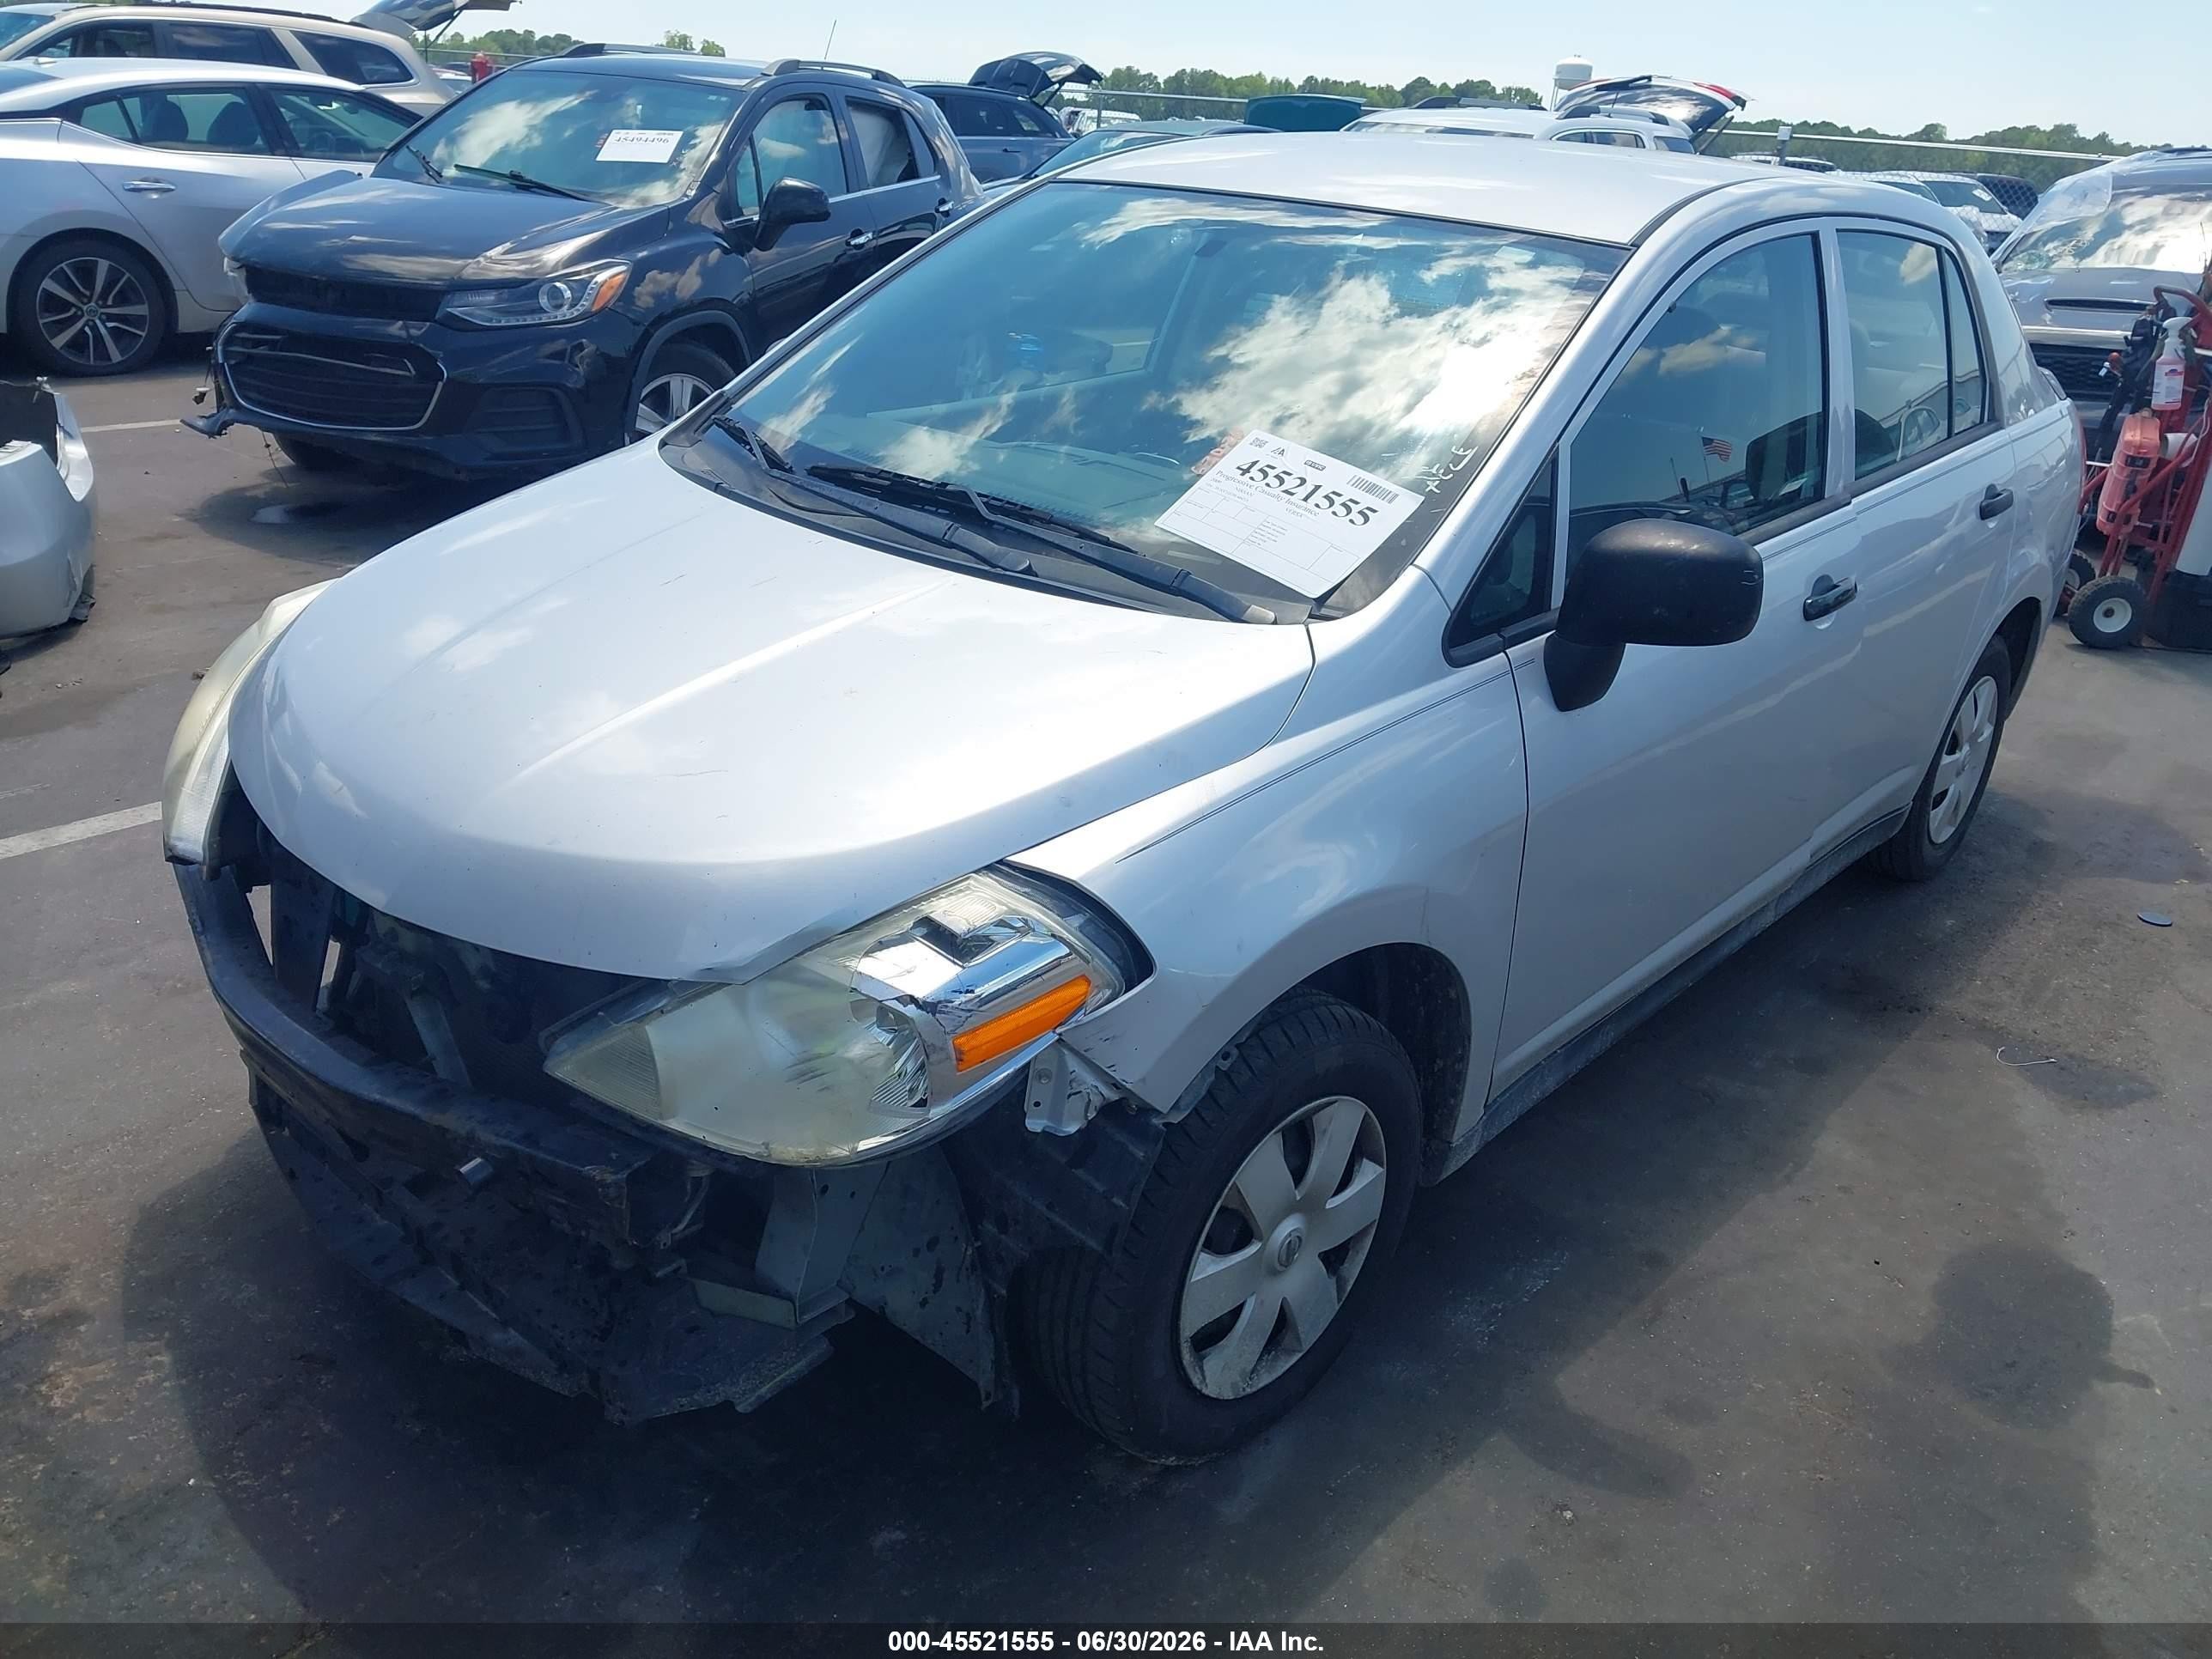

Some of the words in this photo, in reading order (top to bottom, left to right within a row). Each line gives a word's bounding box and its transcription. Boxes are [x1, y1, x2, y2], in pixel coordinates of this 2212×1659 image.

[1215, 470, 1255, 489] Progressive
[1255, 485, 1285, 502] Casualty
[1285, 498, 1320, 517] Insurance
[1235, 459, 1379, 526] 45521555
